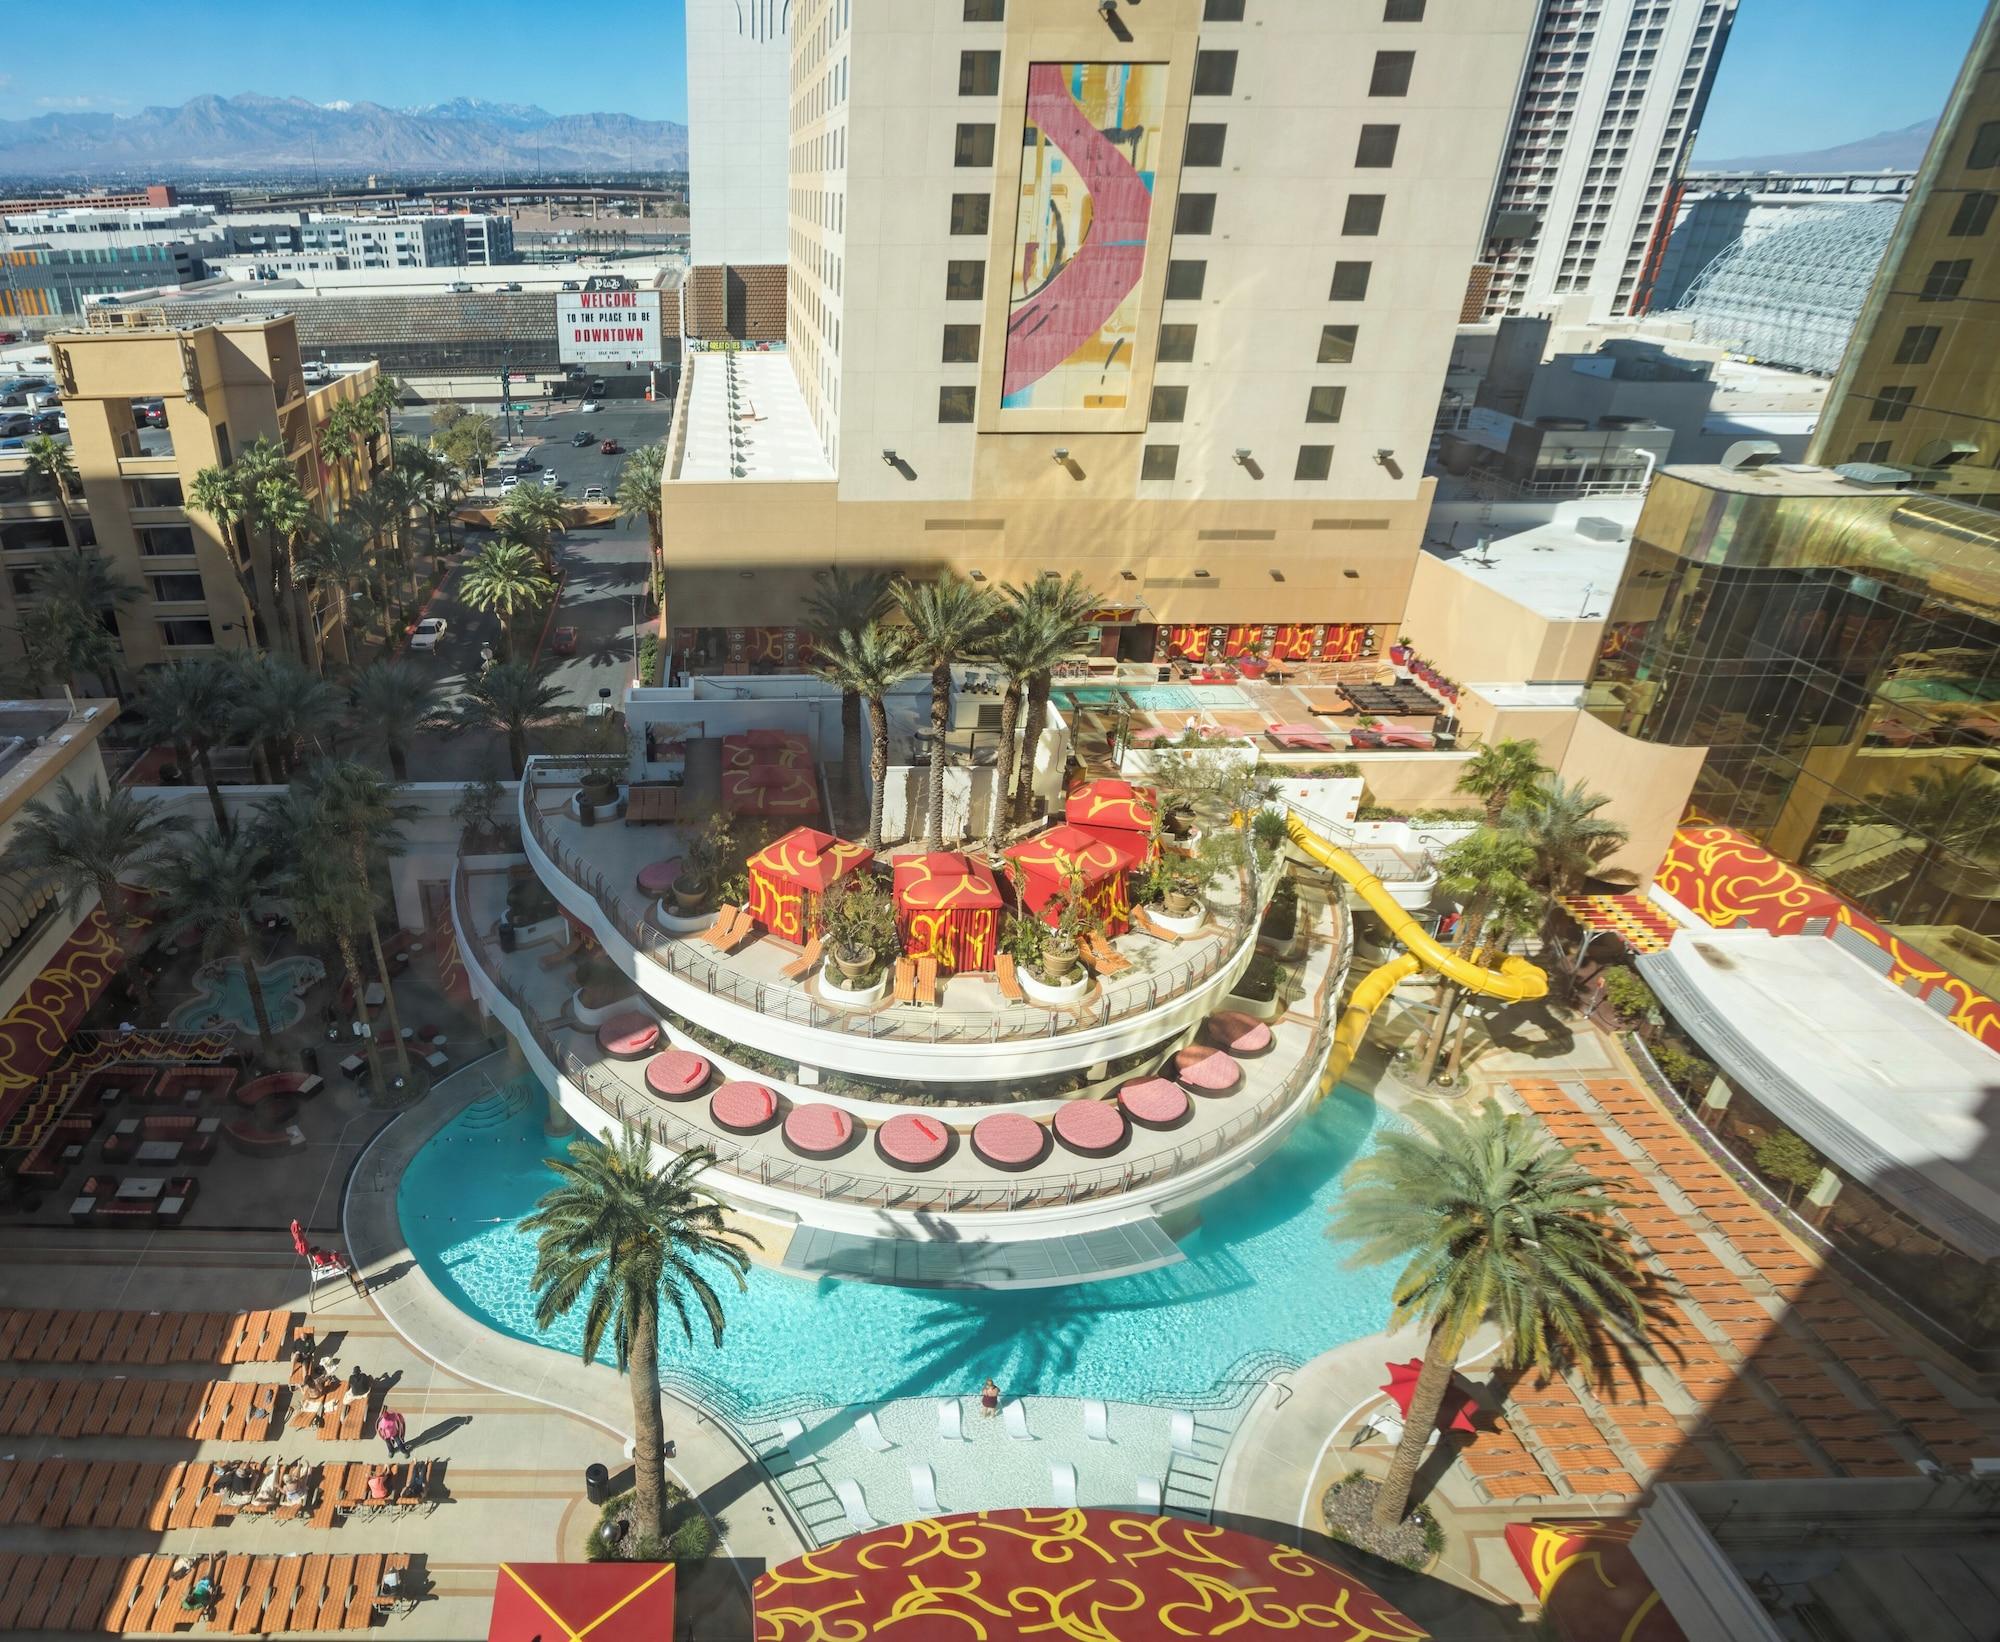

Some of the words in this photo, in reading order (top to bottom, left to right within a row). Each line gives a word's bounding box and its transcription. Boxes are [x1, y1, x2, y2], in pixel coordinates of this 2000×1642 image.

[594, 278, 621, 291] Plaza
[580, 293, 637, 308] WELCOME
[567, 313, 576, 323] TO
[581, 313, 594, 323] THE
[599, 312, 622, 322] PLACE
[628, 312, 637, 322] TO
[641, 312, 650, 322] BE
[575, 328, 644, 342] DOWNTOWN
